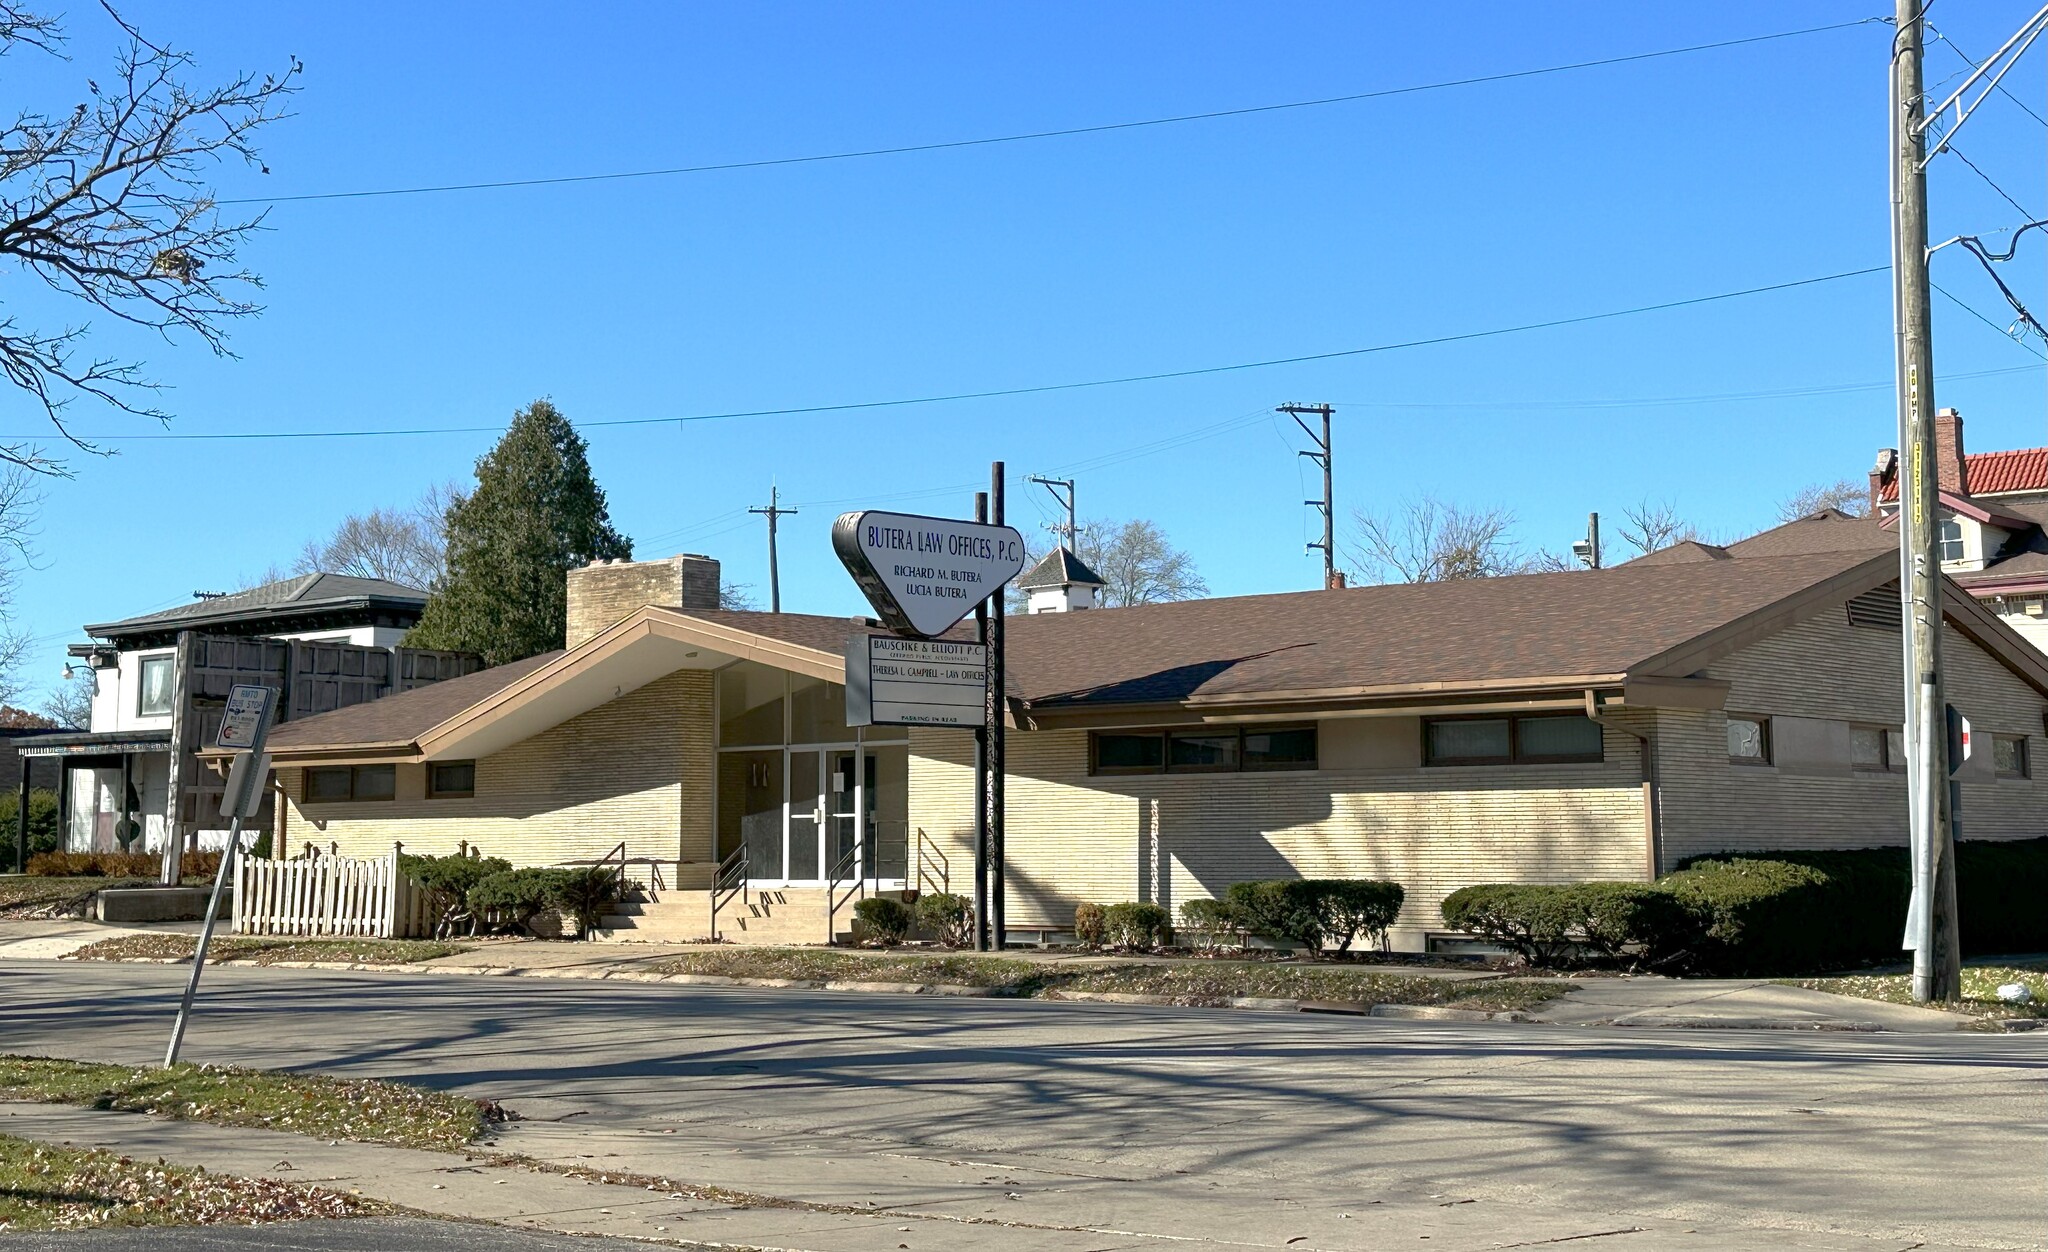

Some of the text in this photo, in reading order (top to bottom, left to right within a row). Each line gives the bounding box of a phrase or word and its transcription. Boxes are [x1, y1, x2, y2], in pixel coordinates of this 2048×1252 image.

[868, 525, 1019, 563] BUTERA LAW OFFICES, P.C.
[894, 565, 982, 583] RICHARD M. BUTERA
[906, 584, 967, 599] LUCIA BUTERA
[874, 640, 918, 652] BAUSCHKE
[921, 644, 928, 652] &
[931, 646, 963, 655] ELLIOTT
[872, 664, 899, 676] THERESA
[907, 667, 938, 678] CAMPBELL
[946, 670, 959, 679] LAW
[961, 671, 985, 681] OFFICES
